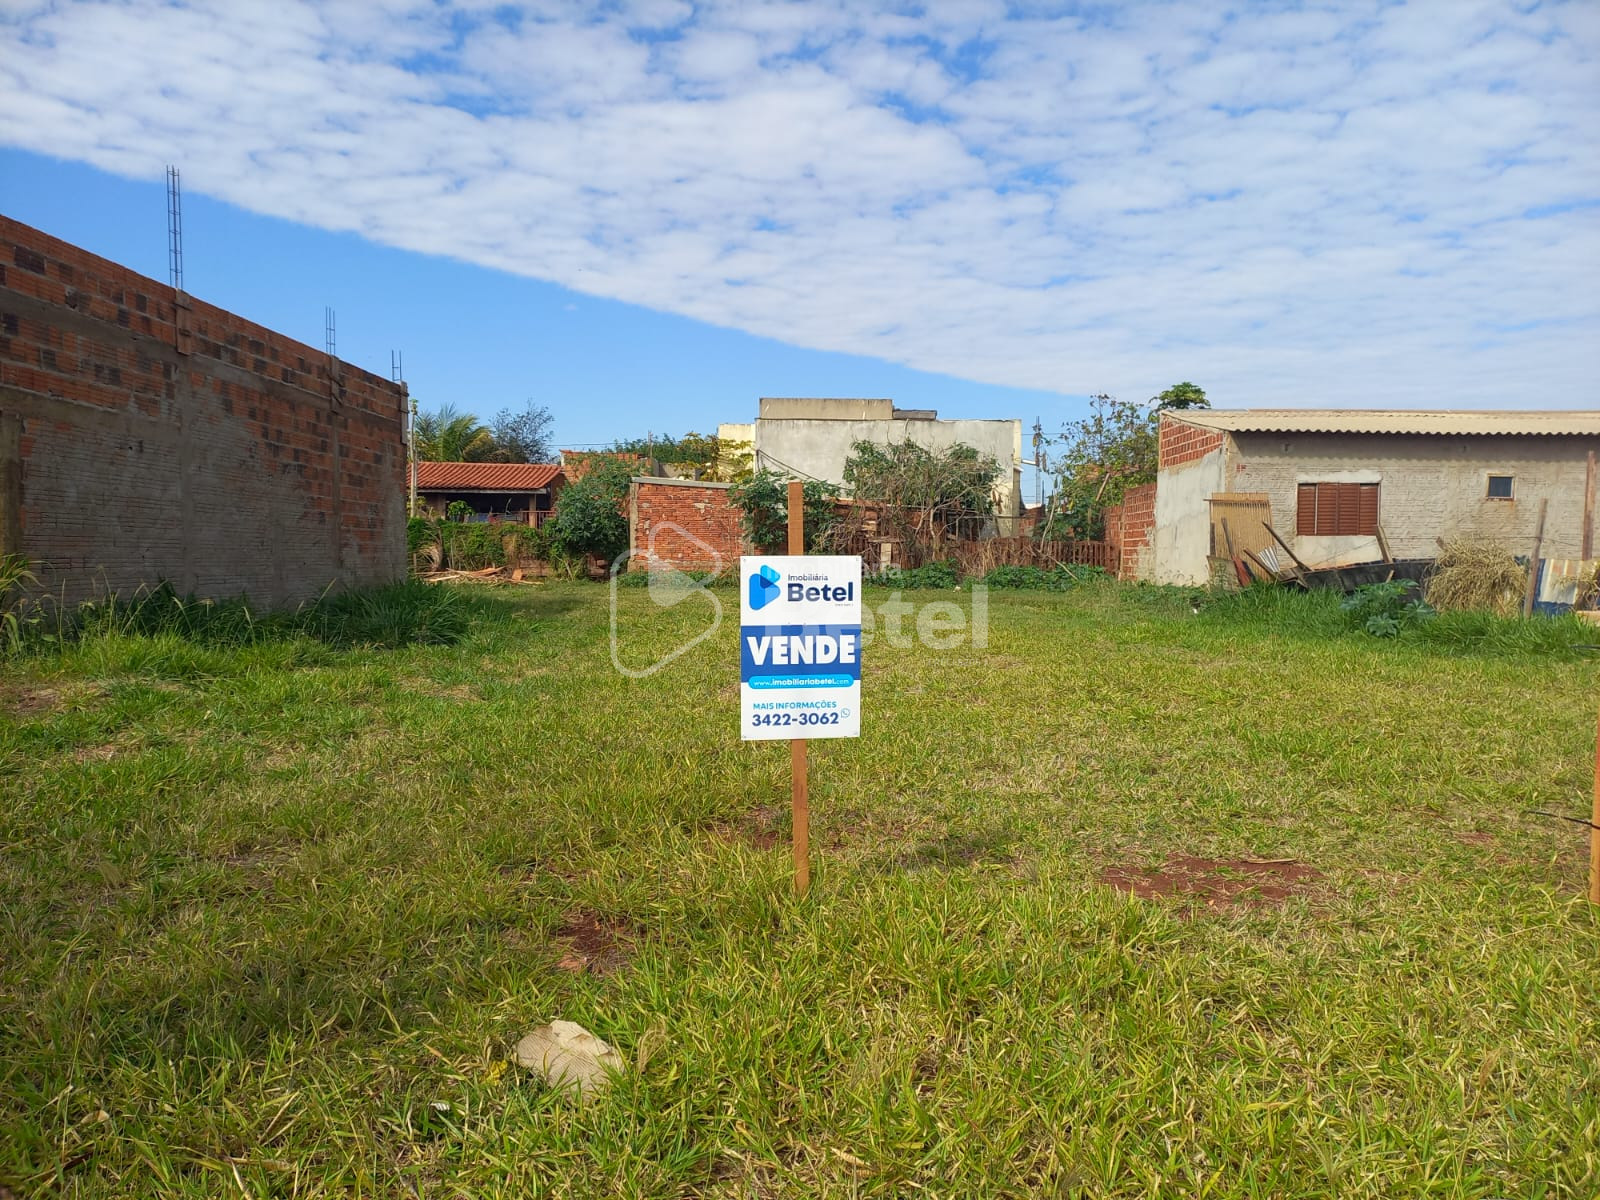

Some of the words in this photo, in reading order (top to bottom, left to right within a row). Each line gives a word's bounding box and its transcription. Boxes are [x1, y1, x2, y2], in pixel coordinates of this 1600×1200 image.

[787, 573, 829, 581] Imobiliária
[787, 581, 854, 602] Betel
[746, 634, 856, 666] VENDE
[753, 677, 850, 687] www.imobiliariabetel.com
[753, 702, 774, 710] MAIS
[775, 700, 837, 710] INFORMAÇÕES
[751, 712, 839, 727] 3422-3062
